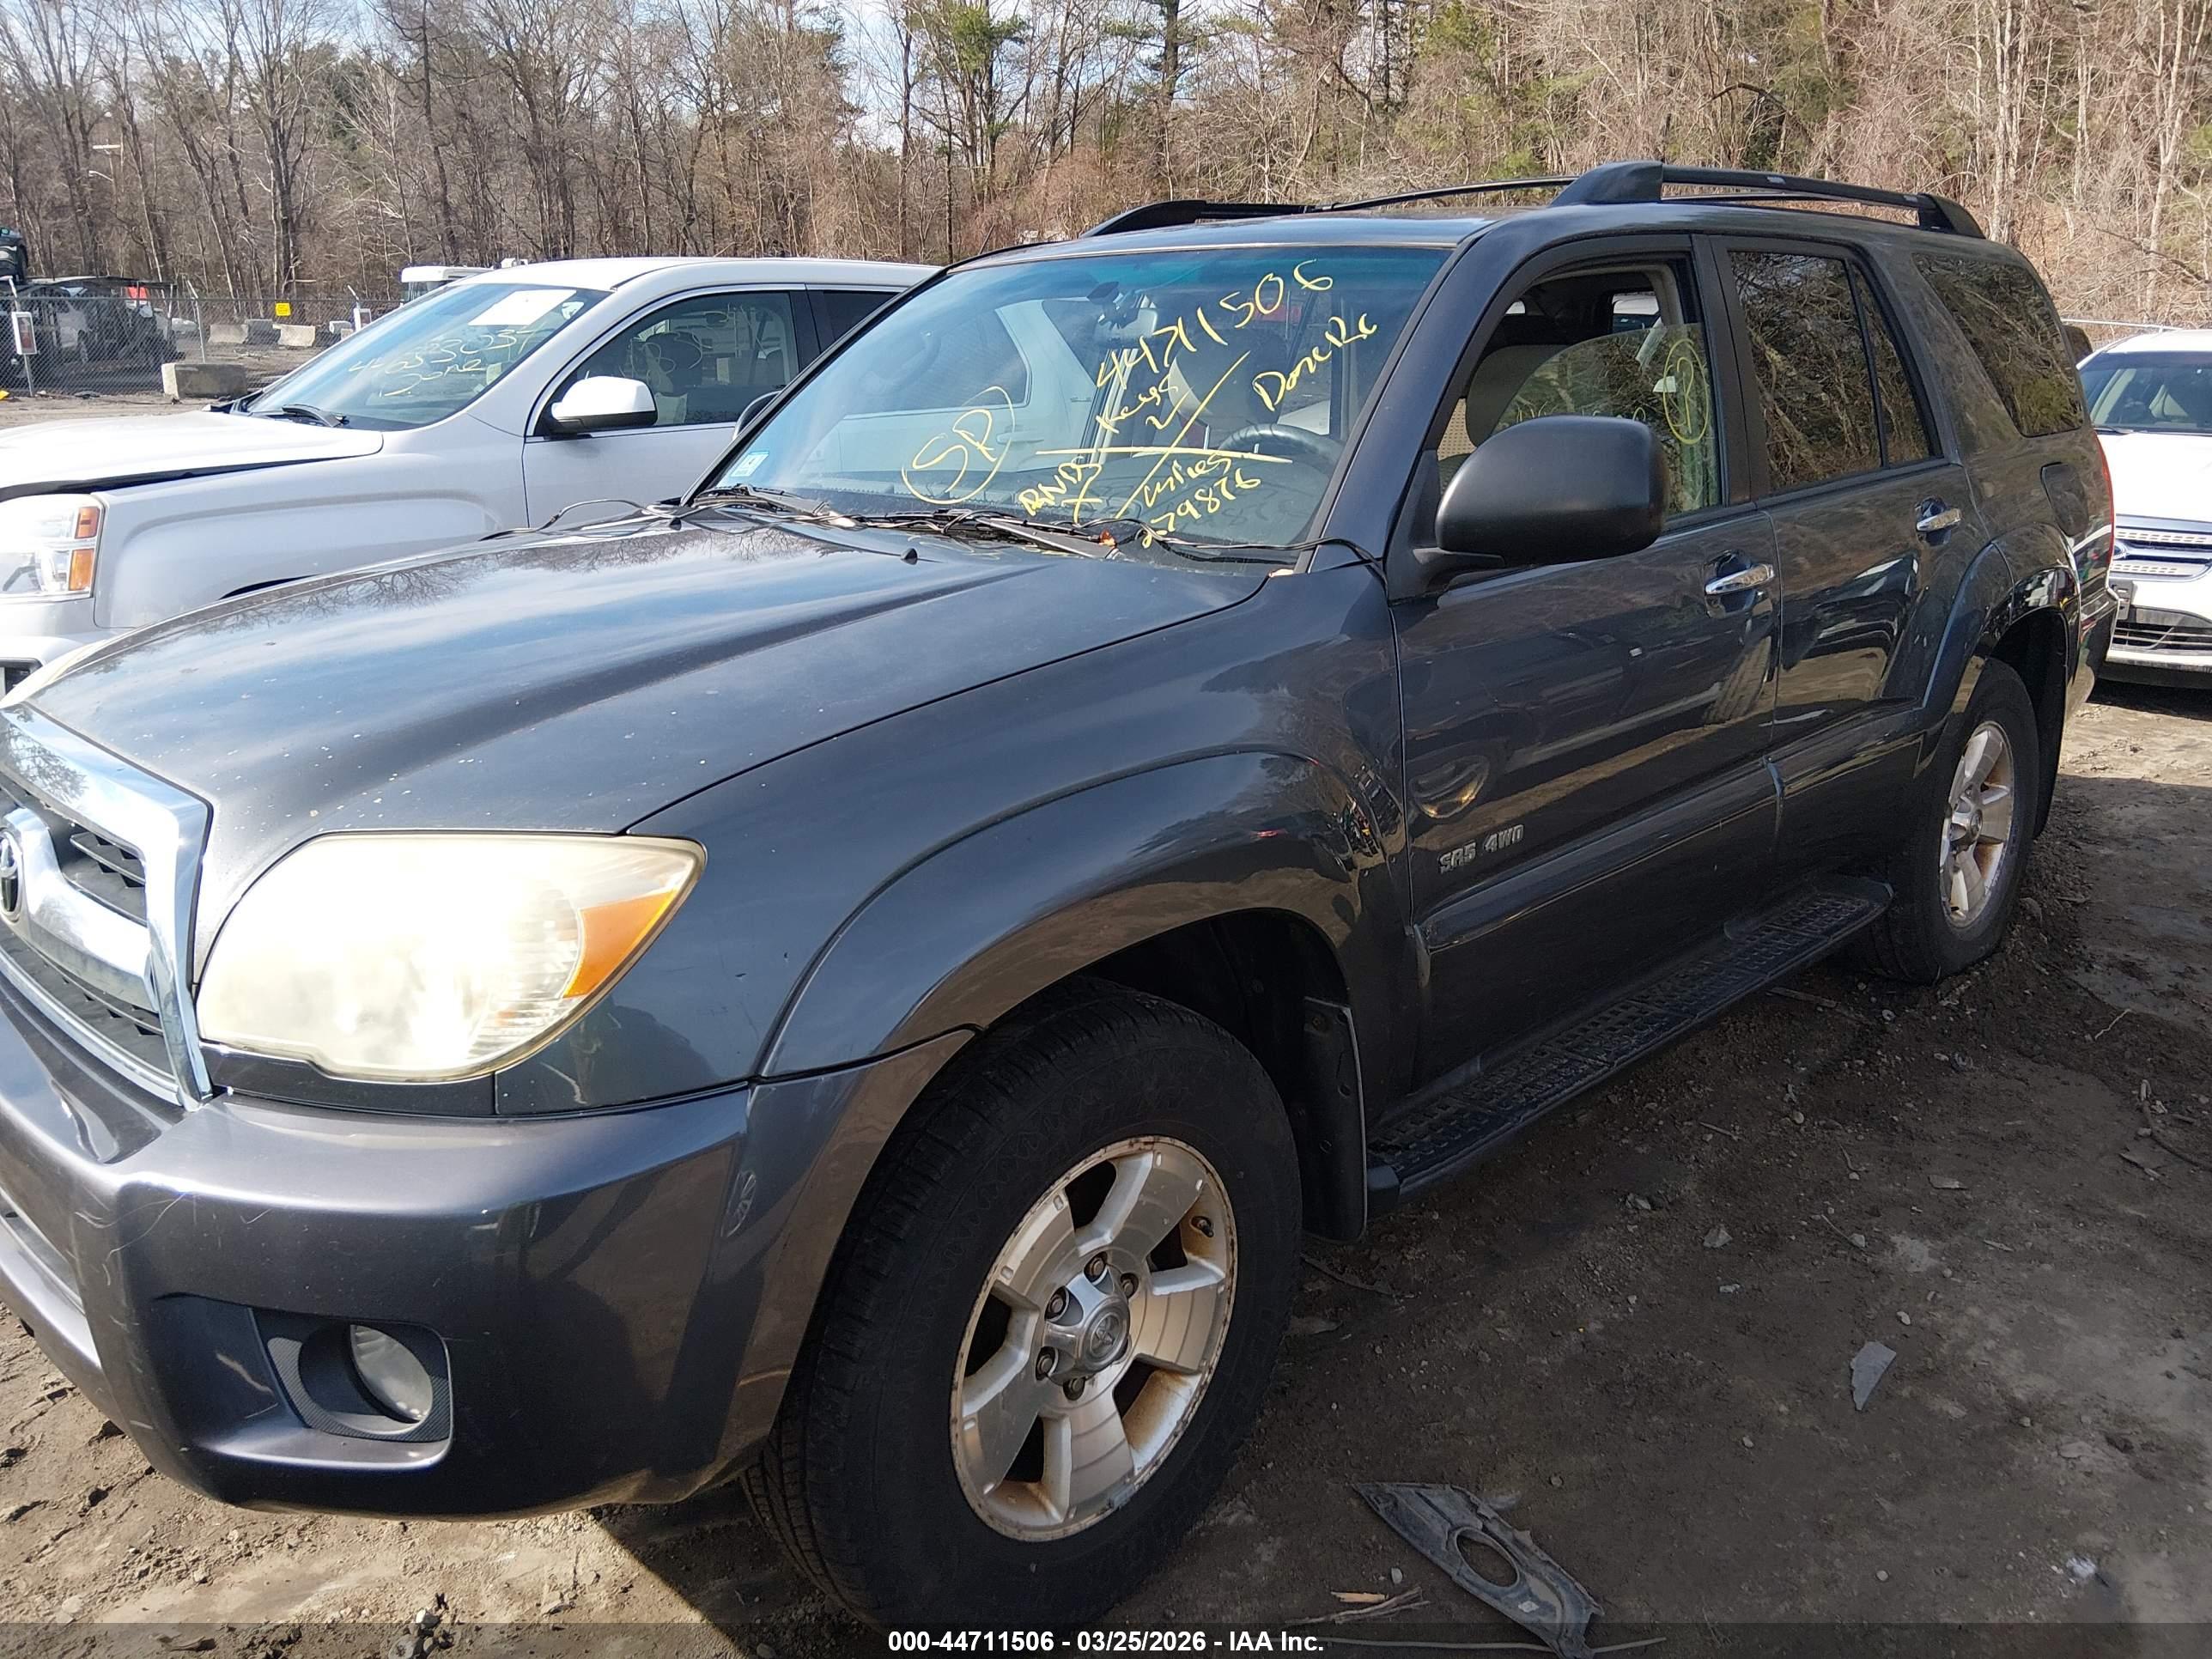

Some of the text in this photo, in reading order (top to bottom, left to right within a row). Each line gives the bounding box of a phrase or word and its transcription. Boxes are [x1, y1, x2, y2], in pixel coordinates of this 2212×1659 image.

[1097, 258, 1334, 390] 44711506
[1438, 824, 1524, 874] SR5 4WD
